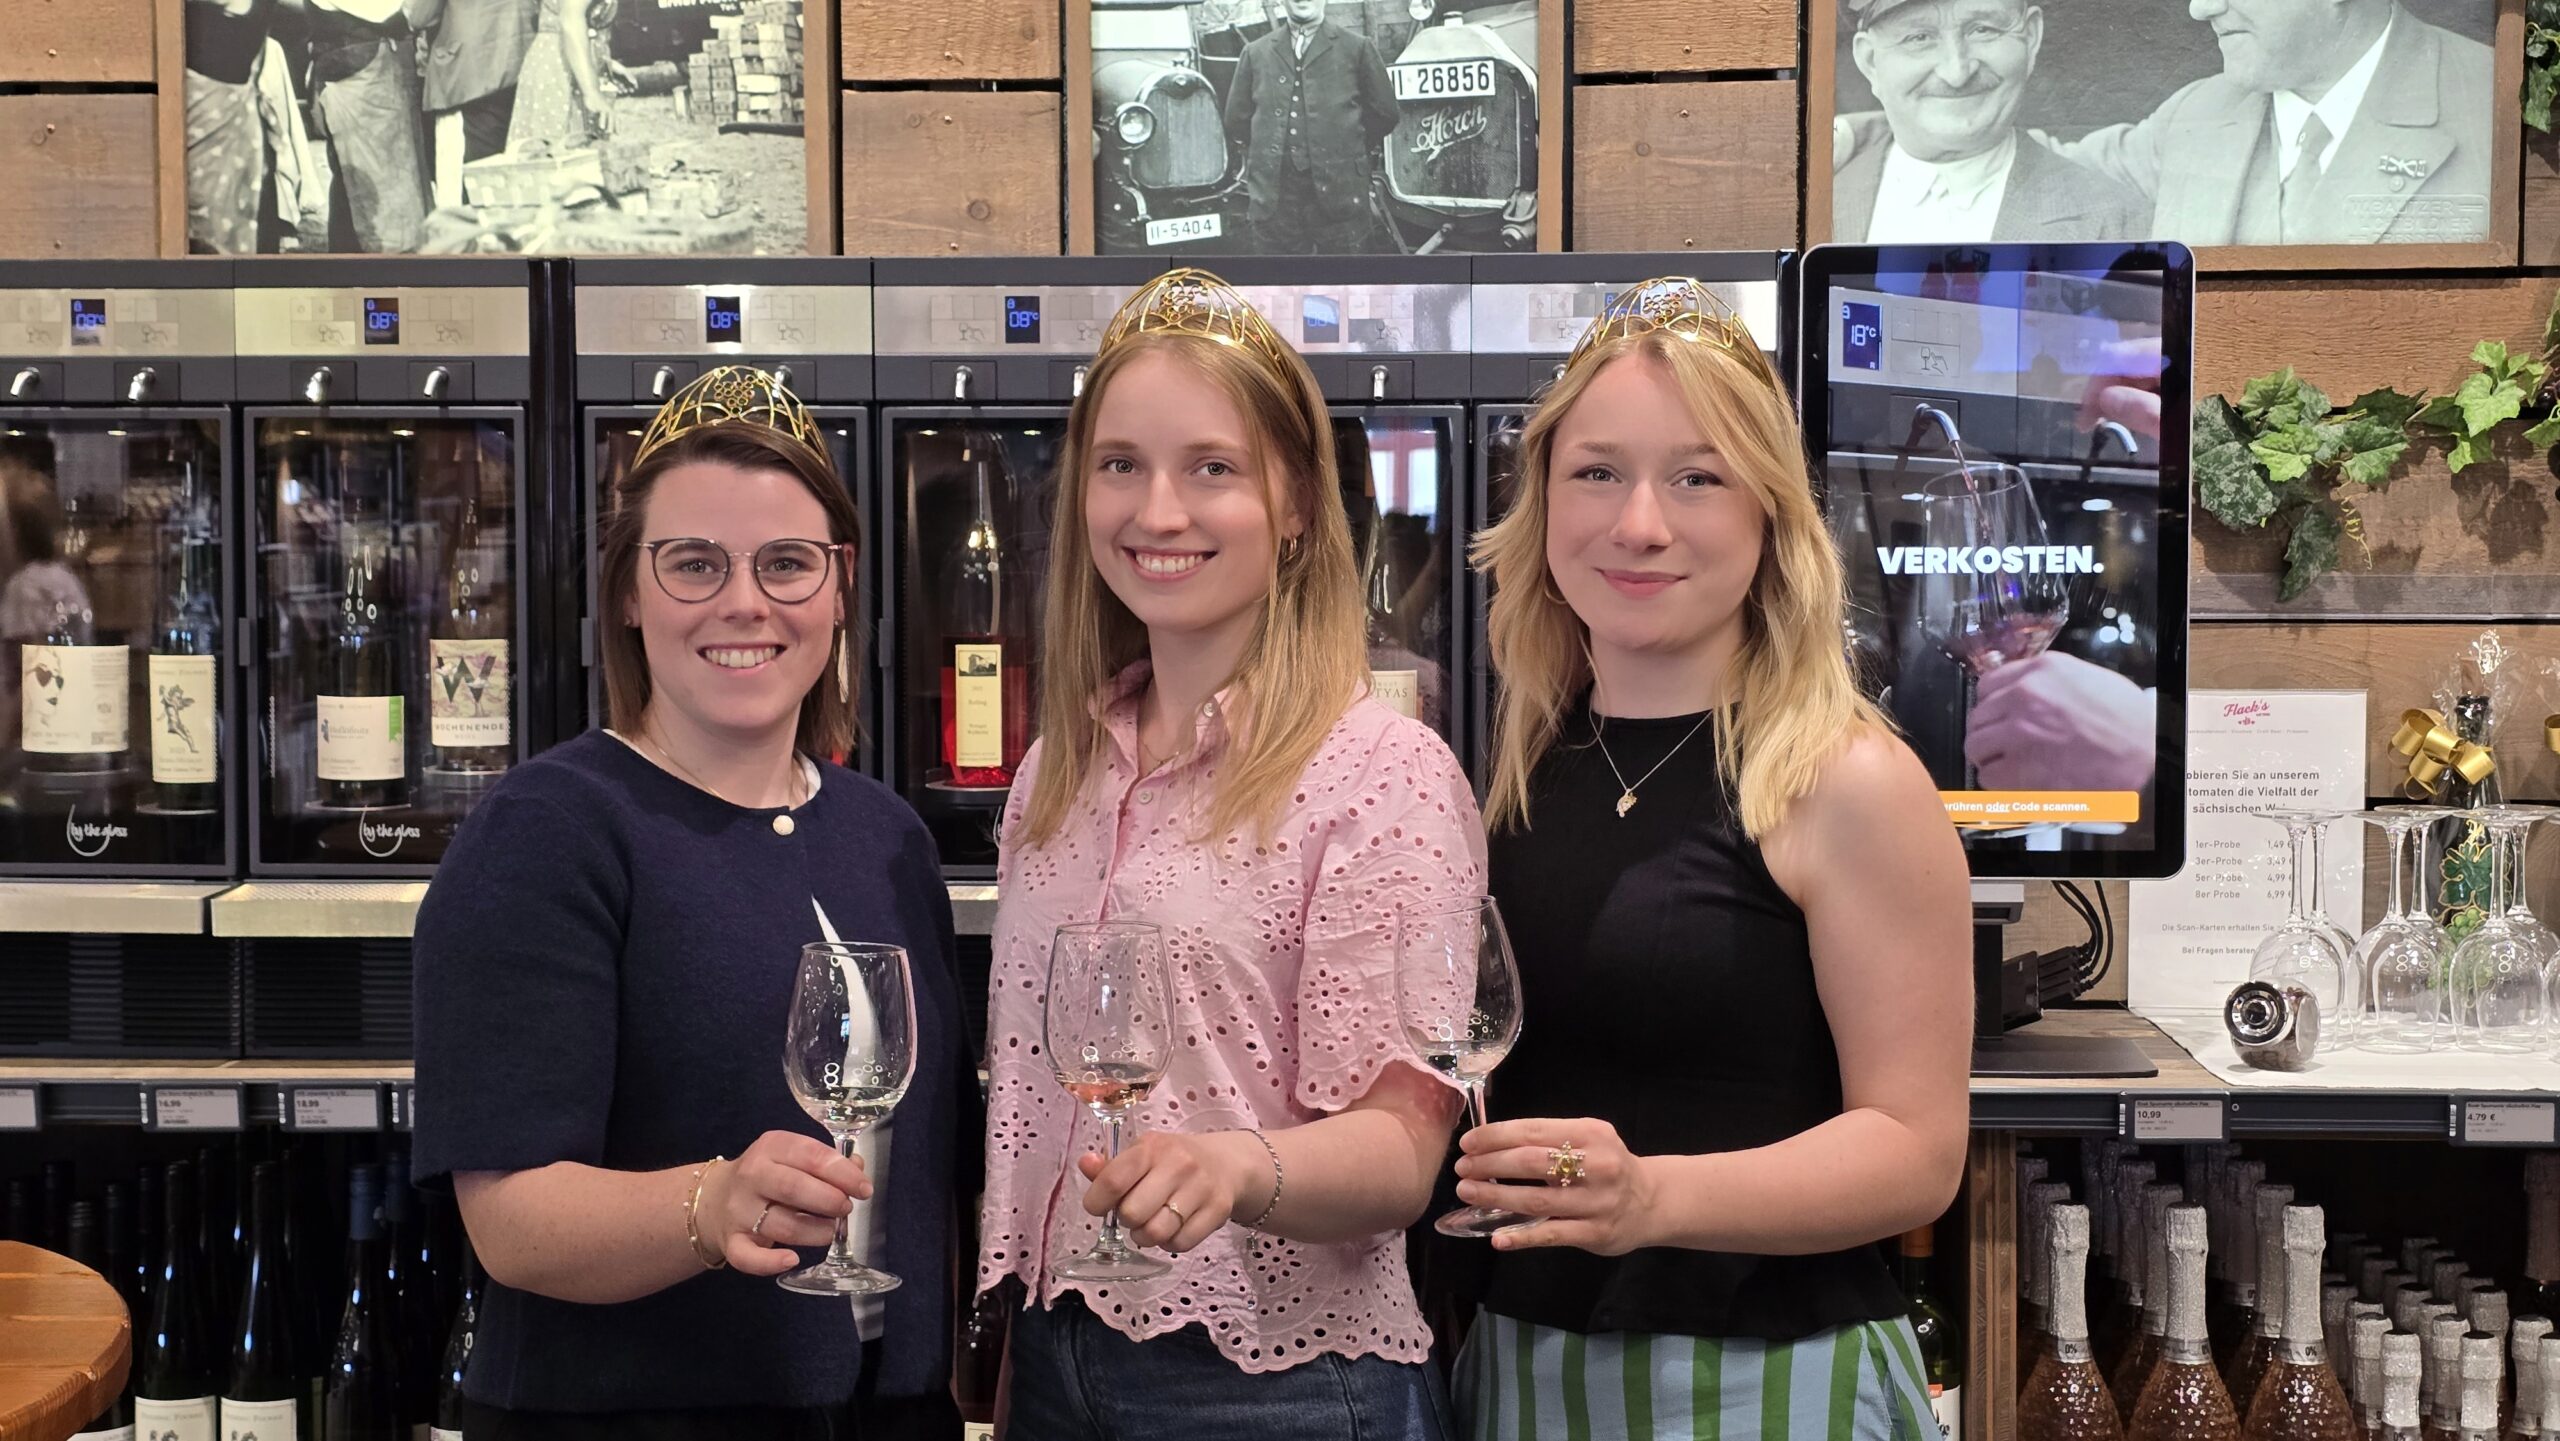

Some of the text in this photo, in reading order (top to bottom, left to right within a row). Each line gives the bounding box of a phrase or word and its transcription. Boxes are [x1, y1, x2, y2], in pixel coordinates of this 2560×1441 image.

[1417, 63, 1489, 94] 26856
[1411, 105, 1488, 160] Horch
[1877, 545, 2104, 575] VERKOSTEN.
[1376, 688, 1408, 698] TYAS
[2223, 700, 2269, 717] Flack's
[435, 723, 504, 731] WOCHENENDE
[2186, 770, 2320, 780] obieren Sie an unserem
[2188, 787, 2319, 797] tomaten die Vielfalt der
[1944, 801, 2090, 813] rühren oder Code scannen.
[2192, 803, 2262, 813] sächsischen
[84, 823, 101, 837] the
[376, 823, 393, 838] the
[2195, 840, 2241, 848] 1er-Probe
[2267, 840, 2285, 849] 1,49
[2195, 857, 2242, 865] 3er-Probe
[2195, 874, 2243, 882] 5er-Probe
[2267, 874, 2286, 883] 4,99
[2195, 891, 2211, 899] 8er
[2213, 891, 2241, 899] Probe
[2267, 891, 2285, 900] 6,99
[2197, 947, 2224, 956] Fragen
[2137, 1111, 2161, 1119] 10,99
[2490, 1113, 2496, 1121] €
[2064, 1344, 2077, 1354] 0%
[2305, 1346, 2317, 1356] 0%
